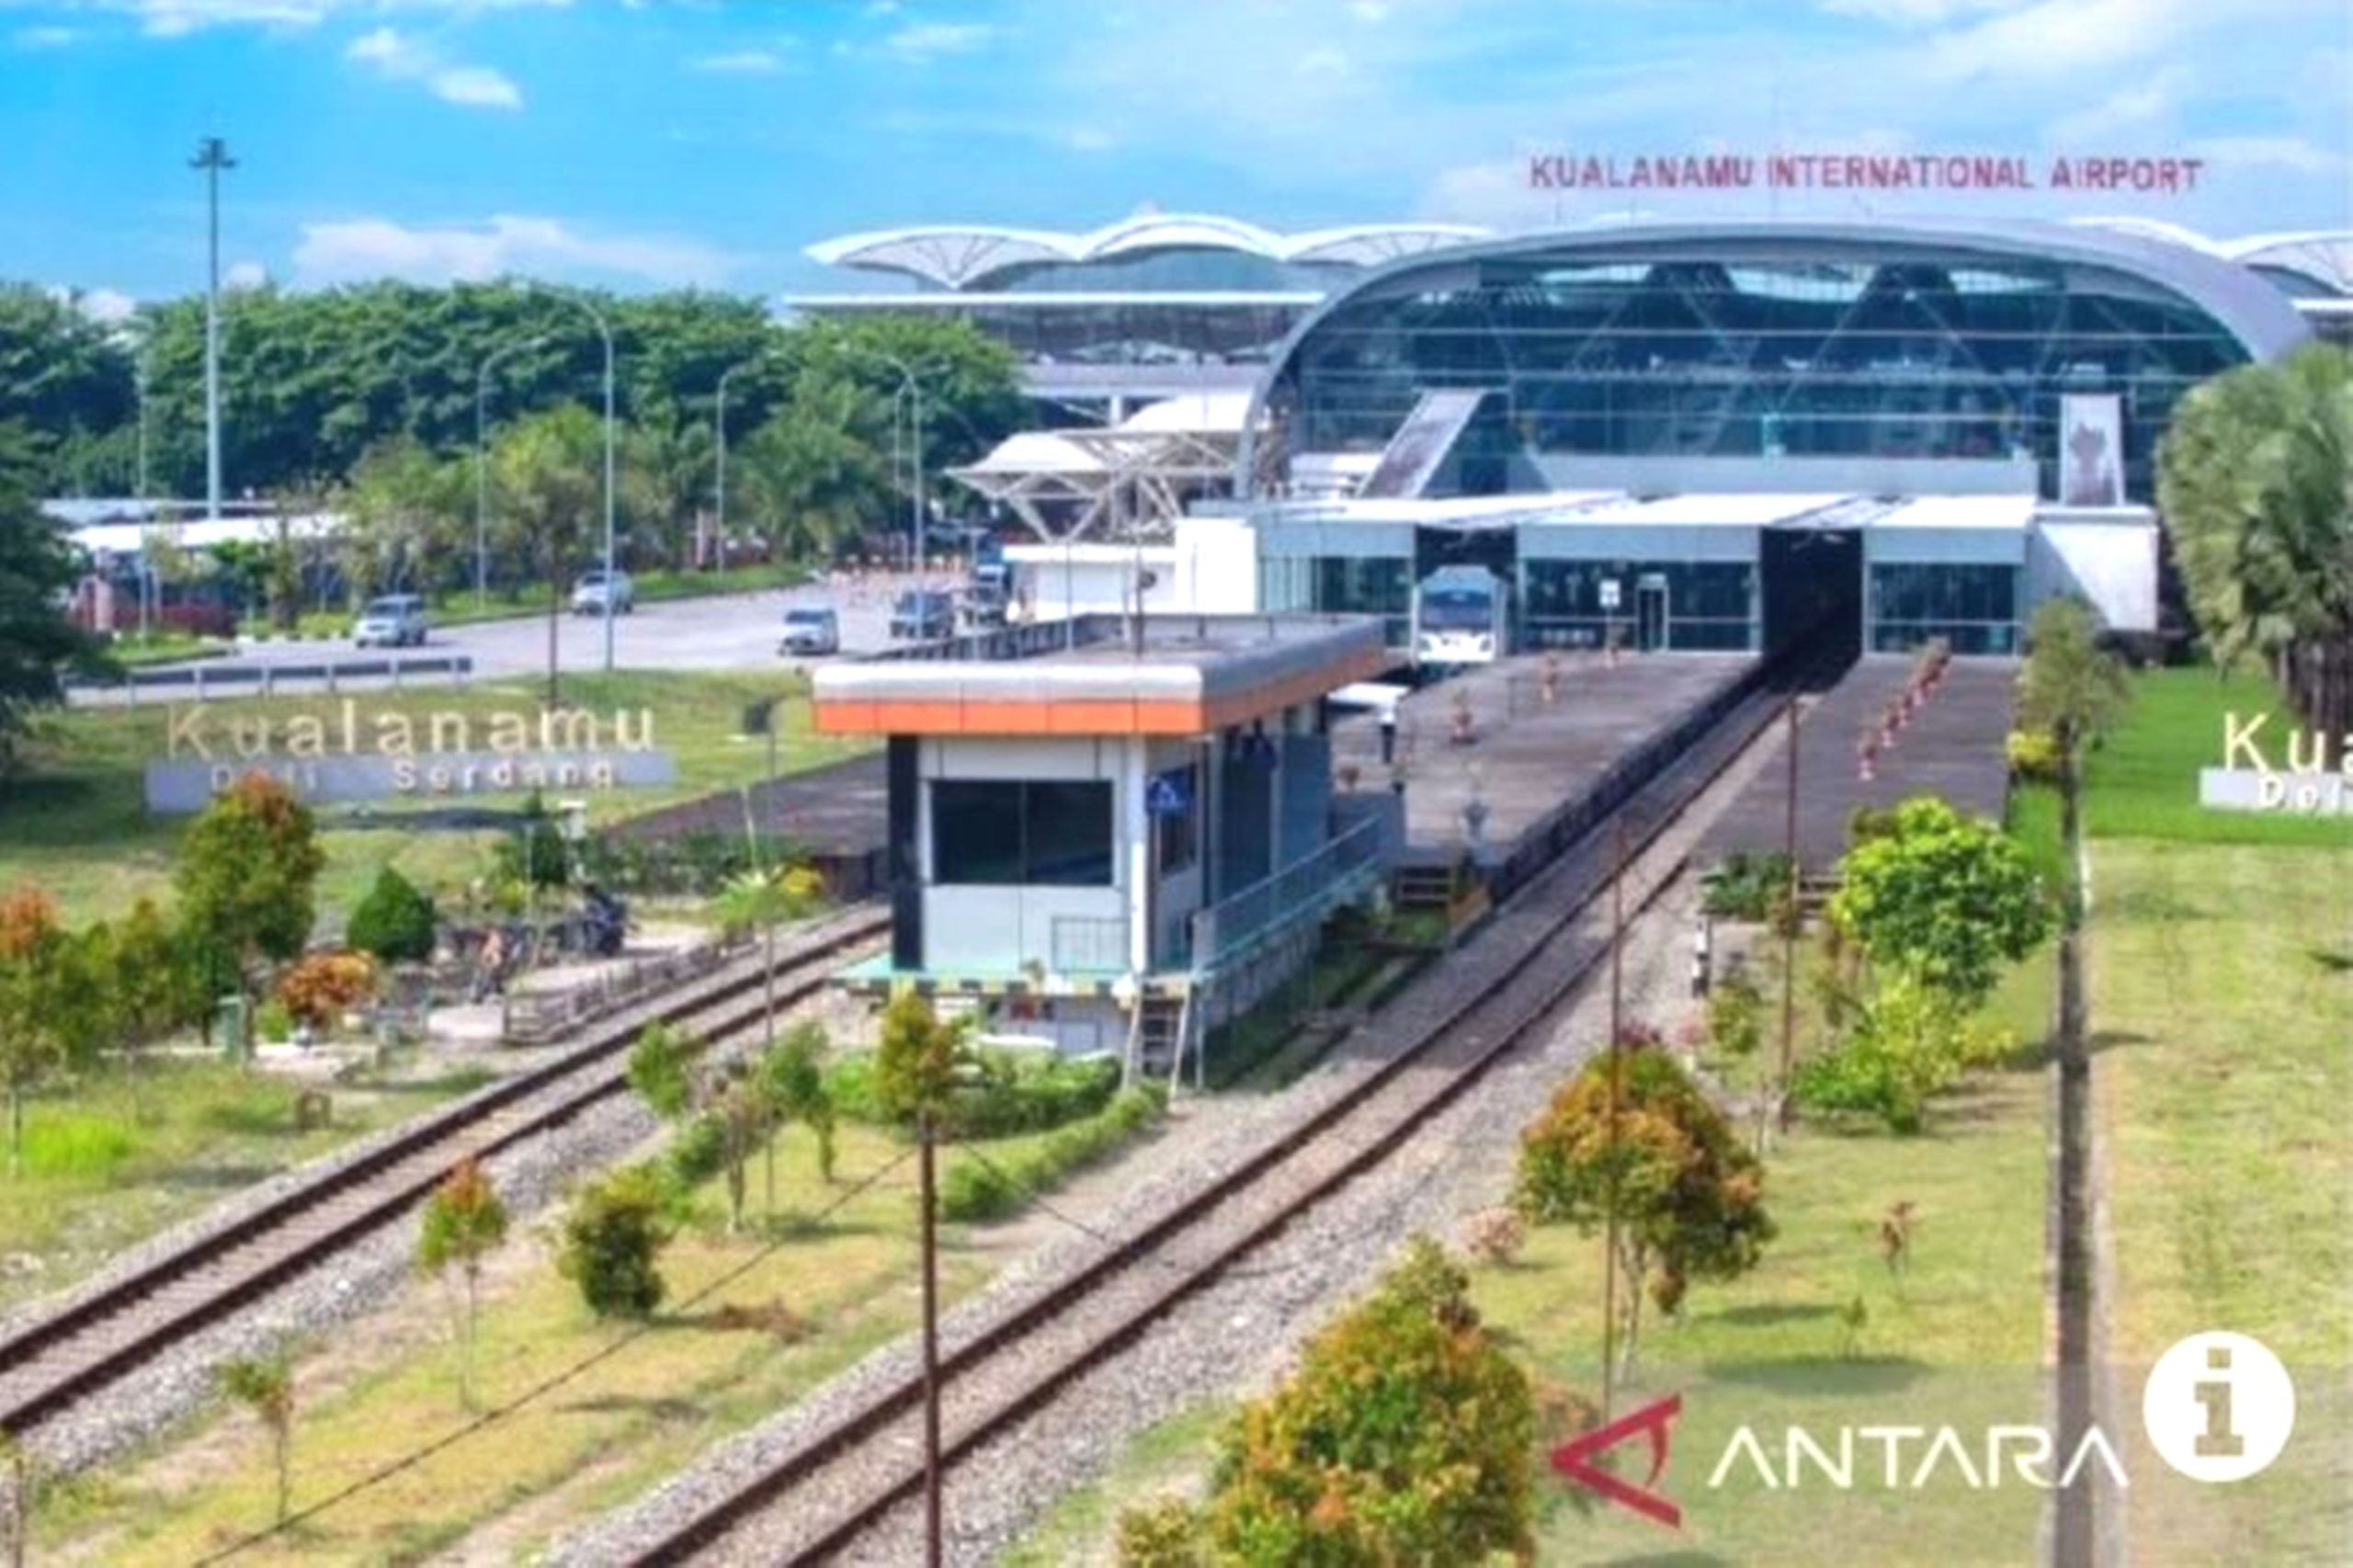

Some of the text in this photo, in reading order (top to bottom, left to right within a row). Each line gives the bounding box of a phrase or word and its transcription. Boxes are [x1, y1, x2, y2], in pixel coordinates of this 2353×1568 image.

[1530, 155, 2204, 192] KUALANAMU INTERNATIONAL AIRPORT
[168, 698, 654, 762] Kualanamu
[210, 757, 613, 796] Dli Serdang
